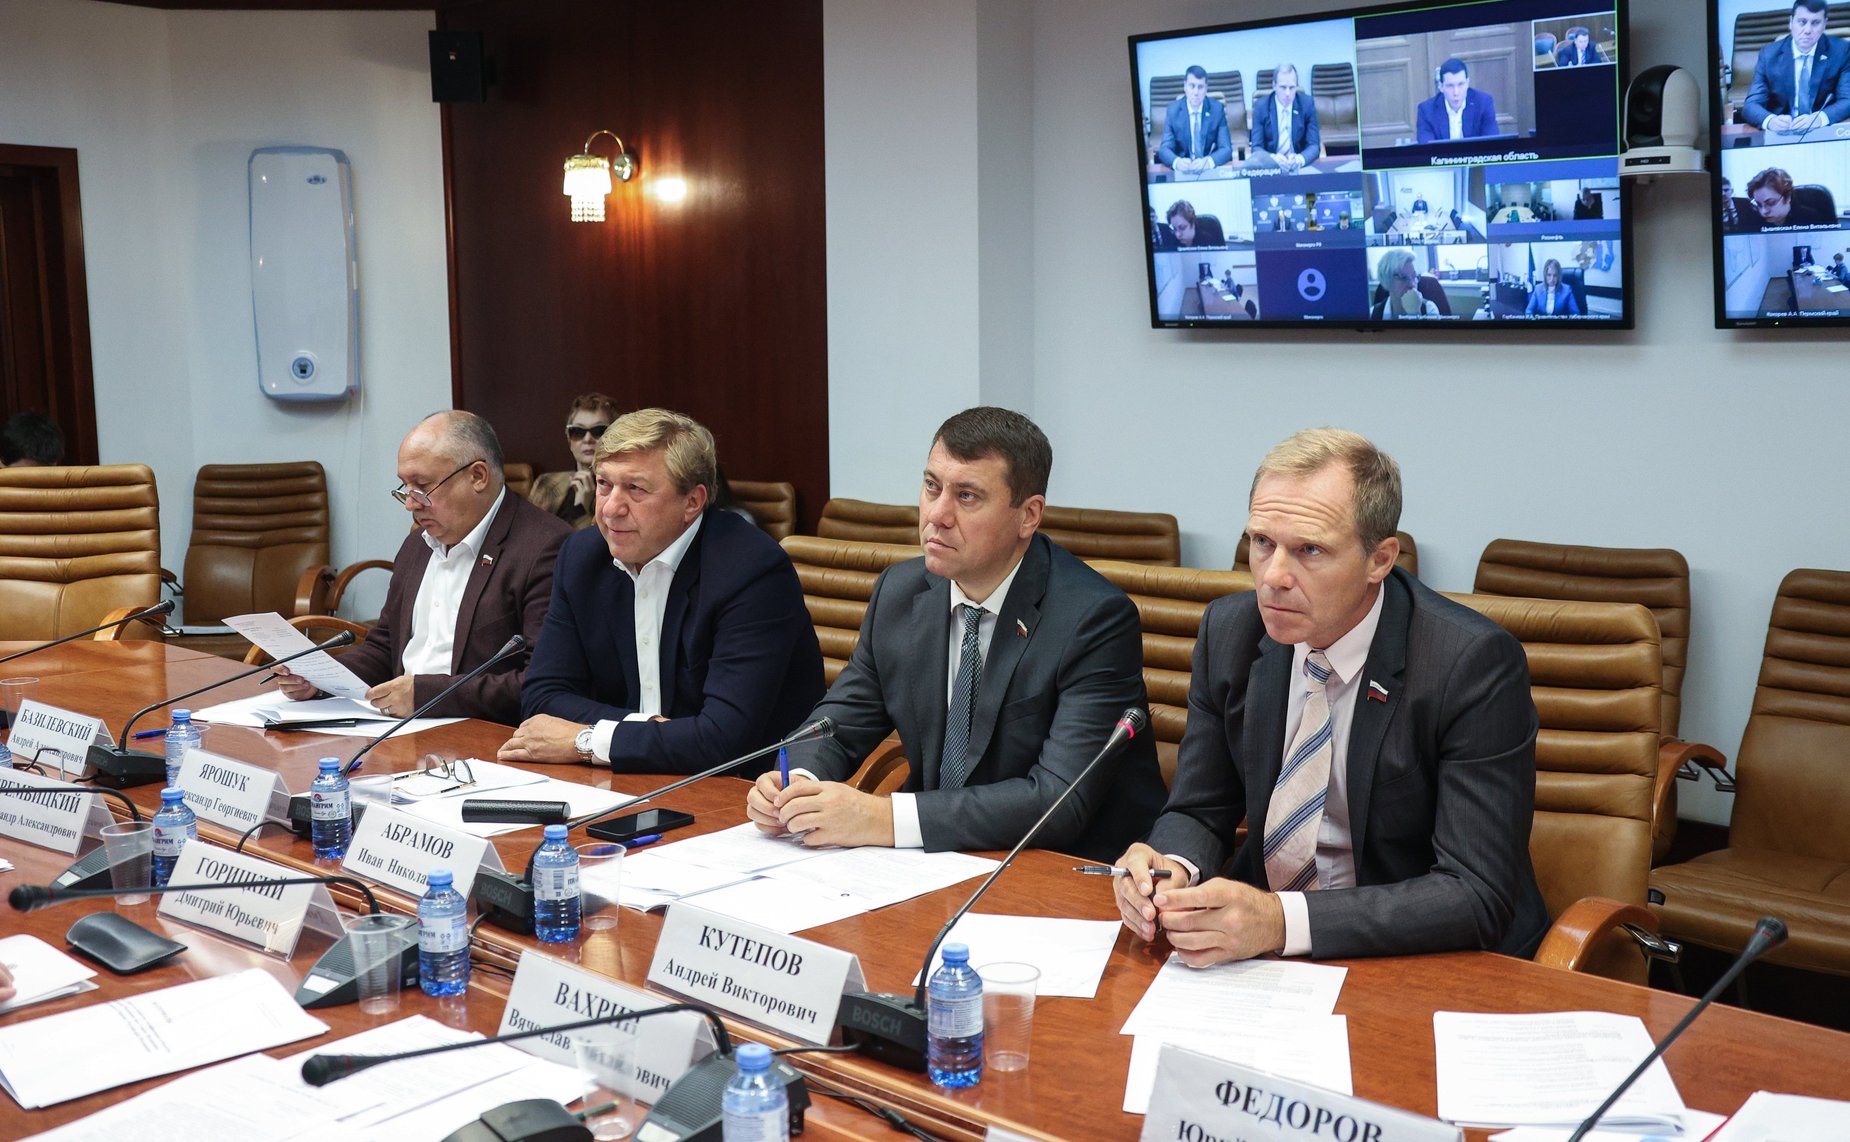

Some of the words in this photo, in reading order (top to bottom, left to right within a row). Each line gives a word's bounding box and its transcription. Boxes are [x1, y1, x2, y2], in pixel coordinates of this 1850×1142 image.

[1241, 168, 1281, 177] Федерации
[1431, 152, 1502, 165] Калининградская
[1503, 151, 1539, 161] область
[20, 708, 92, 741] БАЗИЛЕВСКИЙ
[11, 733, 35, 748] Андрей
[33, 740, 84, 764] Аандрович
[0, 779, 81, 814] РЕМБИЦКИЙ
[182, 790, 213, 811] ександр
[212, 797, 258, 824] Георгиевич
[17, 814, 77, 840] Александрович
[380, 822, 454, 859] АБРАМОВ
[357, 847, 384, 869] Иван
[387, 858, 427, 886] Никола
[481, 882, 512, 908] BOSCH
[174, 890, 224, 917] Дмитрий
[224, 902, 279, 935] Юрьевич
[698, 925, 804, 977] КУТЕПОВ
[663, 957, 719, 988] Андрей
[721, 975, 818, 1025] Викторович
[851, 1005, 903, 1038] BOSCH
[1215, 1080, 1383, 1142] ФЕДОРОВ
